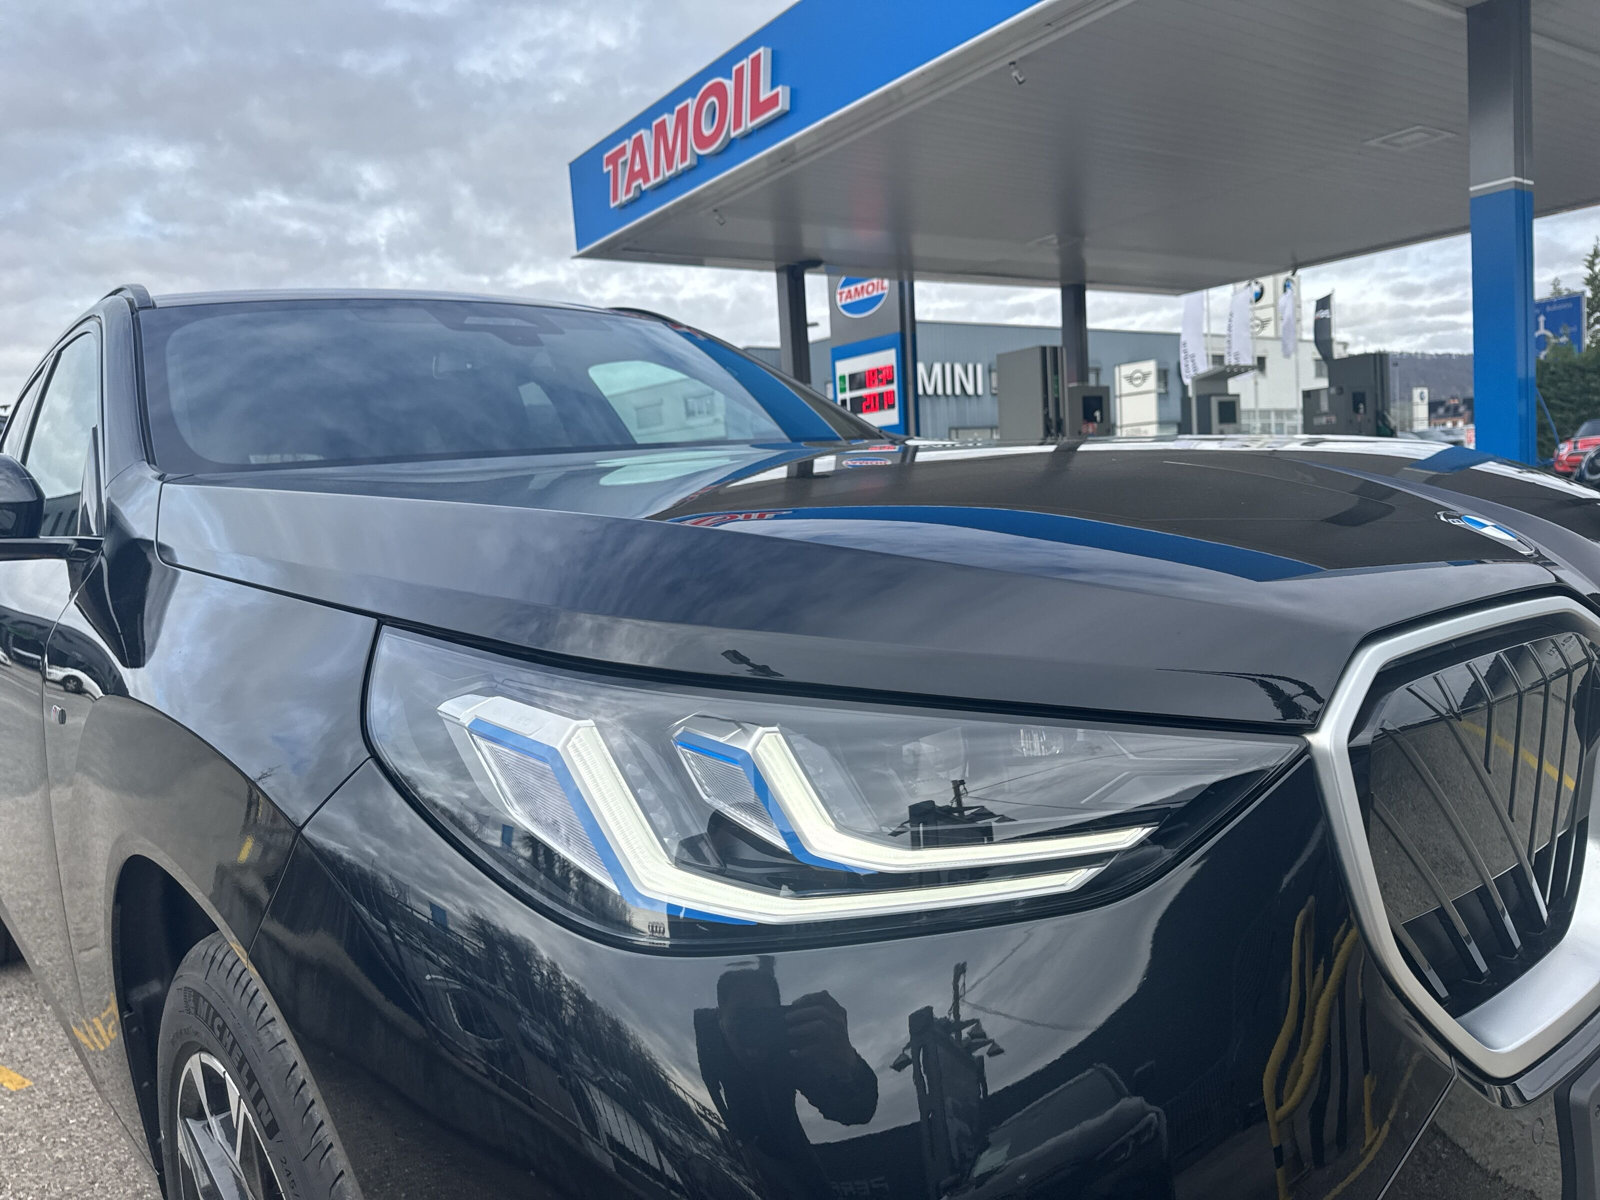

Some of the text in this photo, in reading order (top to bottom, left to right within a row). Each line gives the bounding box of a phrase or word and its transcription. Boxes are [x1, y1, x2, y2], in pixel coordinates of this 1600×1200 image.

[603, 47, 790, 208] TAMOIL
[837, 278, 888, 303] TAMOIL
[917, 361, 983, 396] MINI
[197, 995, 275, 1128] MICHELIN
